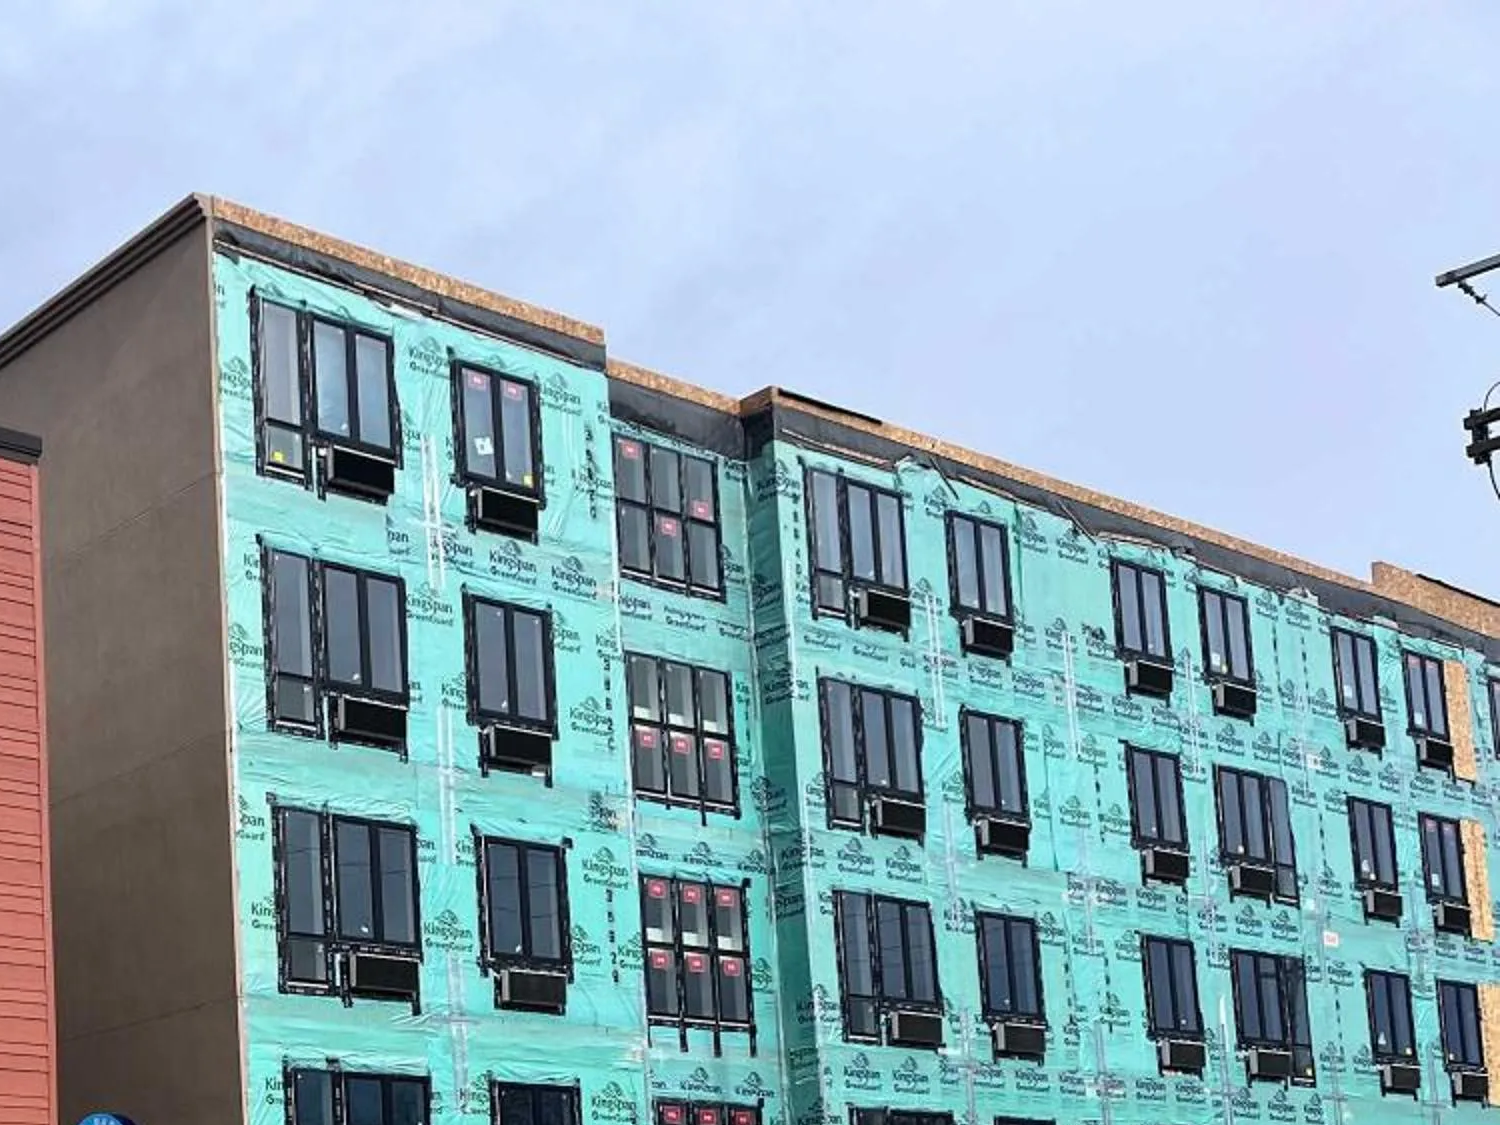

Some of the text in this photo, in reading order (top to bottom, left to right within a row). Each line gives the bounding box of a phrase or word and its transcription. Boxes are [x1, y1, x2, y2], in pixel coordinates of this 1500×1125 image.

[489, 550, 537, 573] Kingspan
[551, 565, 597, 588] Kingspan
[582, 859, 629, 878] Kingspan
